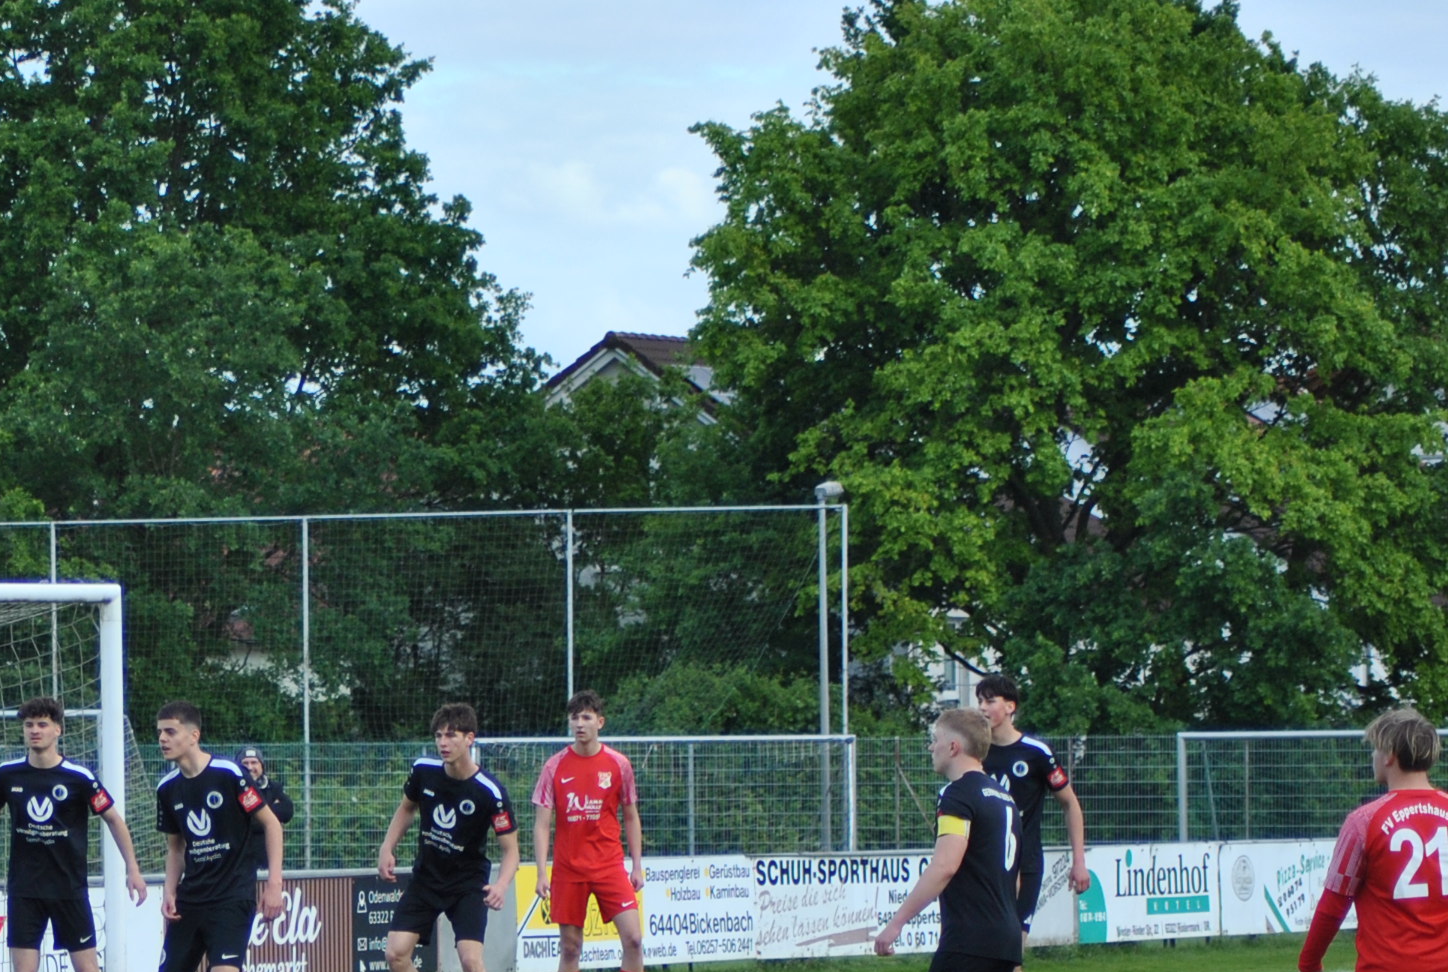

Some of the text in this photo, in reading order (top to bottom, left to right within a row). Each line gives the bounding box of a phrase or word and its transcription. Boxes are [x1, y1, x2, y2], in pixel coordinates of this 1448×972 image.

[1381, 816, 1394, 835] FV
[709, 864, 750, 879] Gerüstbau
[756, 858, 910, 886] SCHUH-SPORTHAUS
[1115, 849, 1210, 897] Lindenhof
[1390, 826, 1448, 900] 21
[645, 866, 700, 884] Bauspenglerei
[671, 887, 701, 901] Holzbau
[710, 884, 749, 899] Kaminbau
[758, 890, 799, 918] Preise
[801, 886, 819, 908] die
[792, 916, 829, 938] lassen
